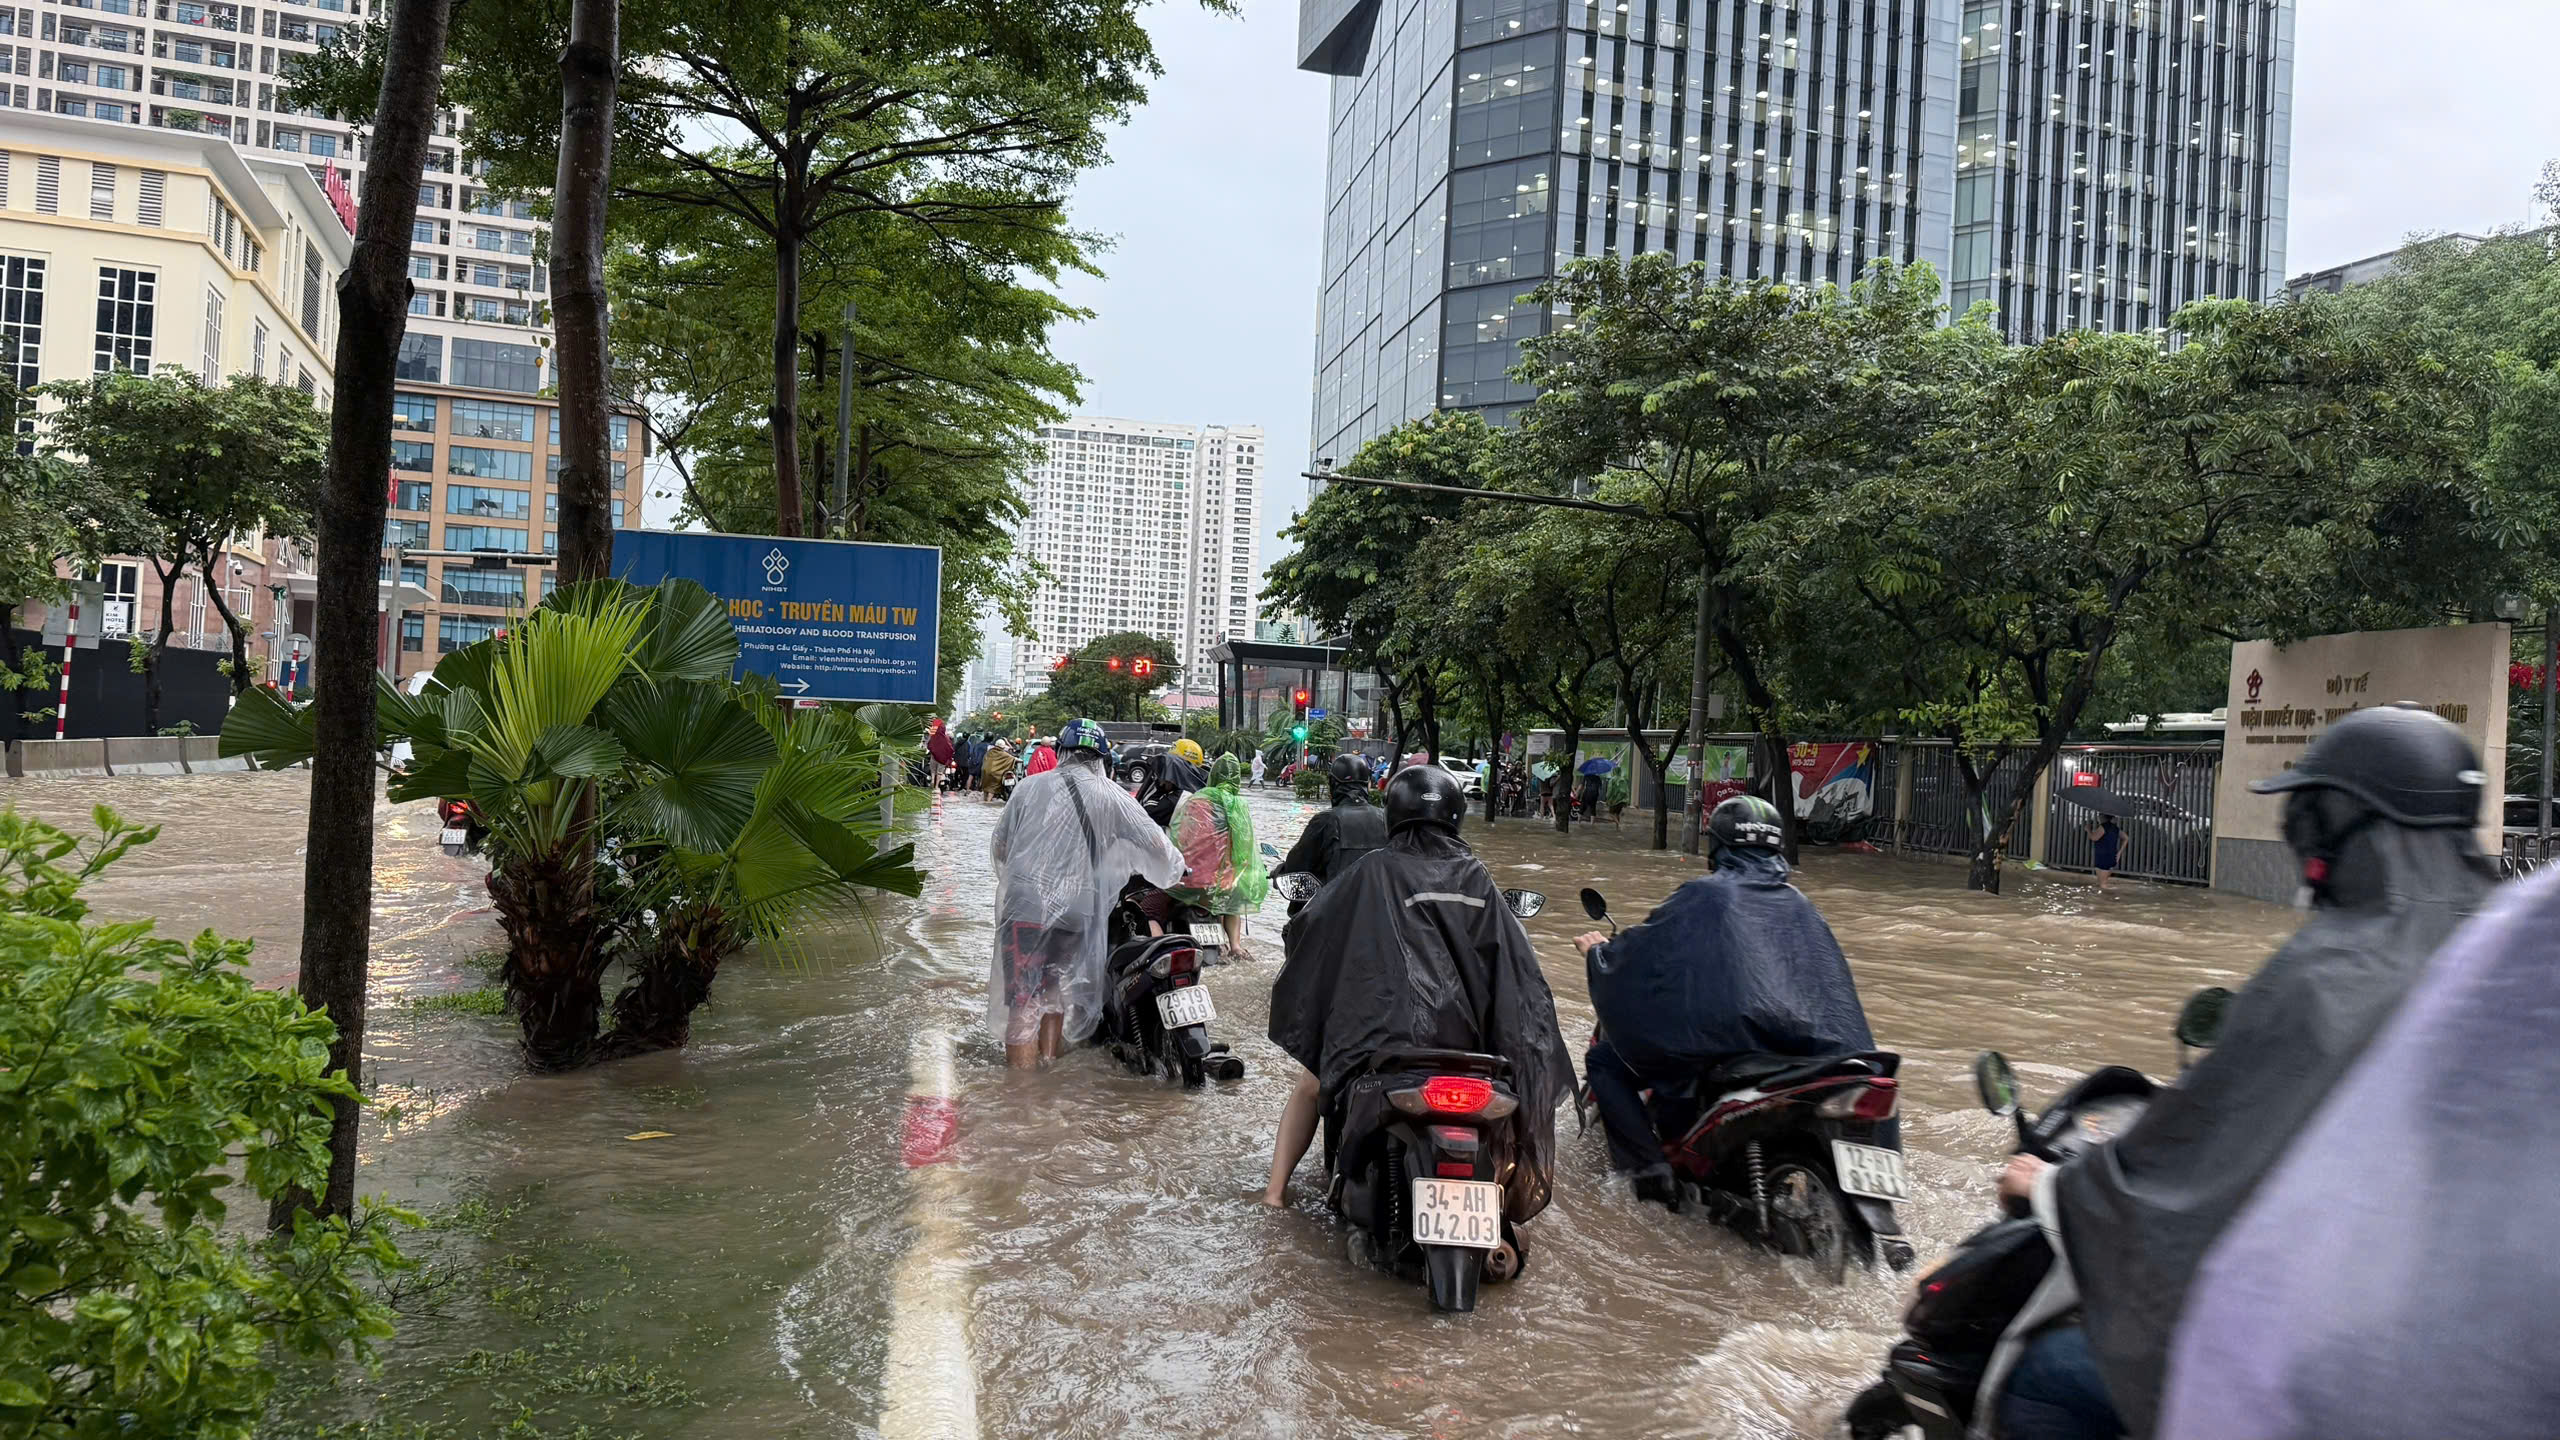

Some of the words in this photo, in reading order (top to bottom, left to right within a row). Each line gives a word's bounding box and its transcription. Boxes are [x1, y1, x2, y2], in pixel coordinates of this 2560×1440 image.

[729, 599, 763, 621] HỌC
[780, 598, 844, 622] TRUYỀN
[849, 602, 887, 624] MÁU
[892, 606, 918, 625] TW
[734, 625, 797, 635] HEMATOLOGY
[799, 628, 820, 636] AND
[822, 629, 854, 638] BLOOD
[856, 631, 917, 641] TRANSFUSION
[1135, 659, 1151, 673] 27
[1426, 1183, 1486, 1212] 34-AH
[1418, 1212, 1495, 1242] 042.03
